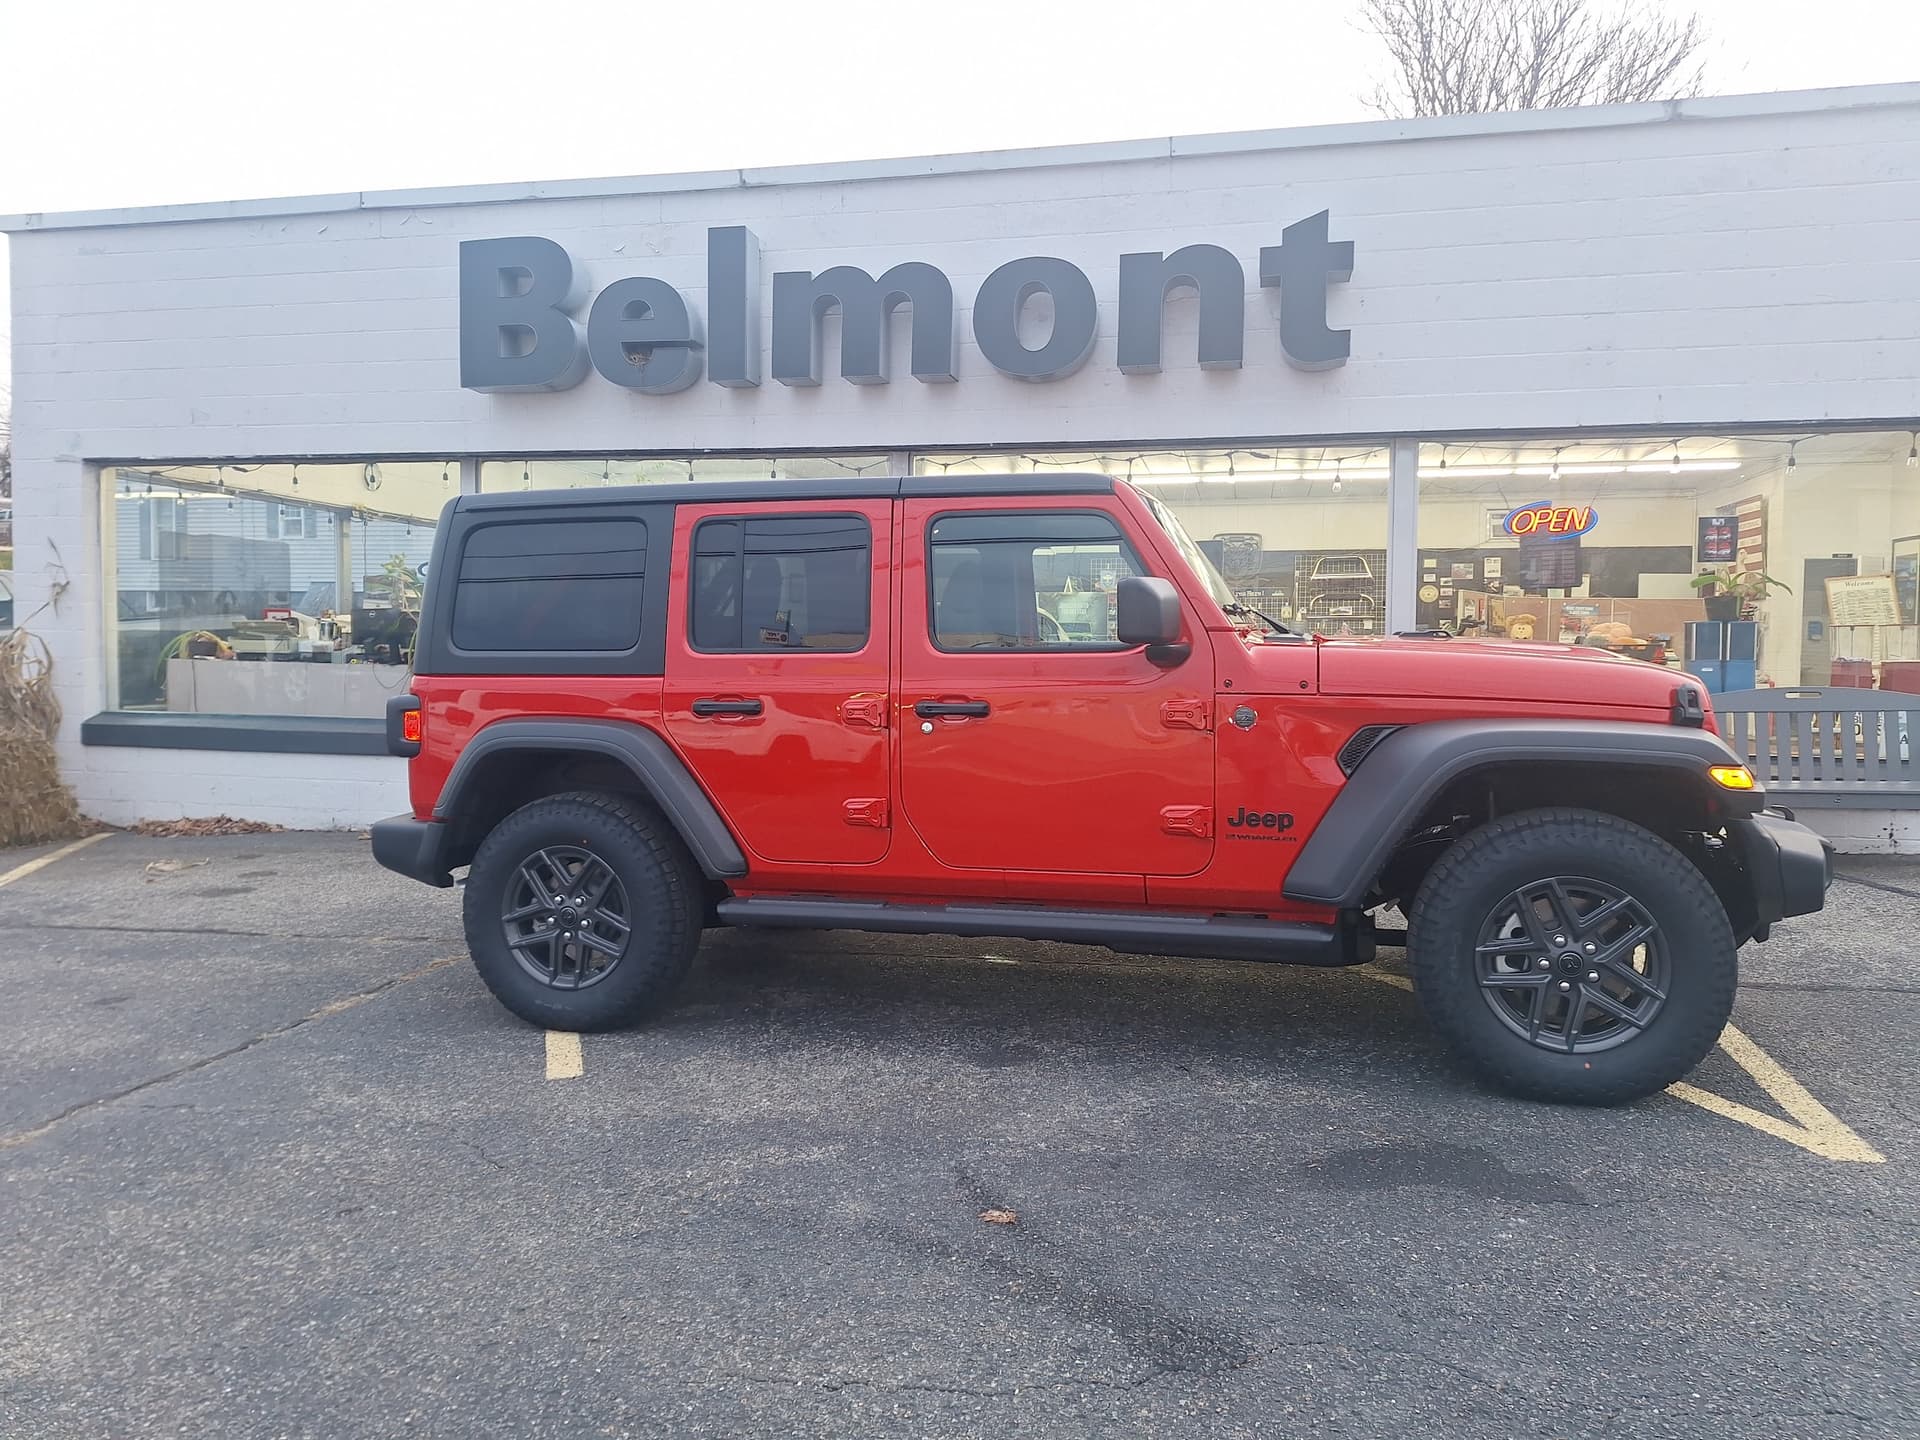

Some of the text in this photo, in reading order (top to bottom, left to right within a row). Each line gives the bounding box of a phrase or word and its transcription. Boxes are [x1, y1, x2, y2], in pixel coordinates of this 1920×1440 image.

[459, 209, 1356, 396] Belmont
[1511, 506, 1591, 534] OPEN
[1227, 807, 1294, 832] Jeep
